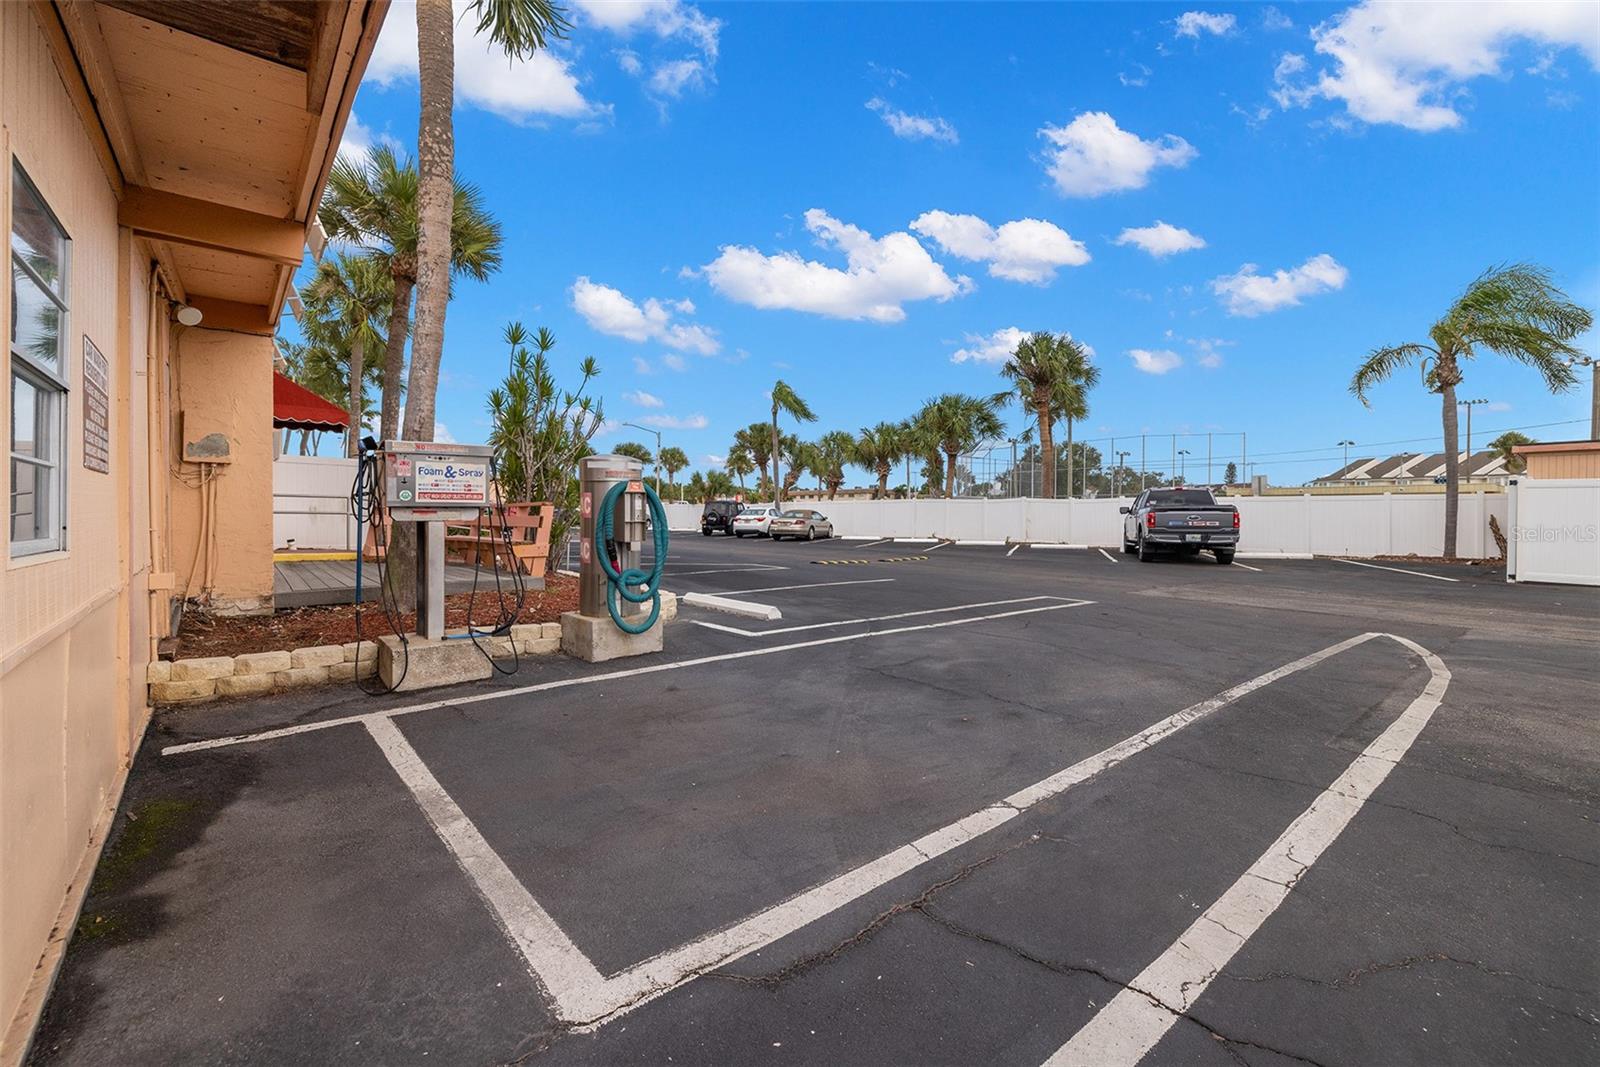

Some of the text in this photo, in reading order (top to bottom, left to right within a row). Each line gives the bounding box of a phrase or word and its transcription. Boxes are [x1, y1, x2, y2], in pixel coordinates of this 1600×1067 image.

[418, 466, 443, 476] Foam
[444, 465, 457, 479] &
[458, 468, 484, 478] Spray
